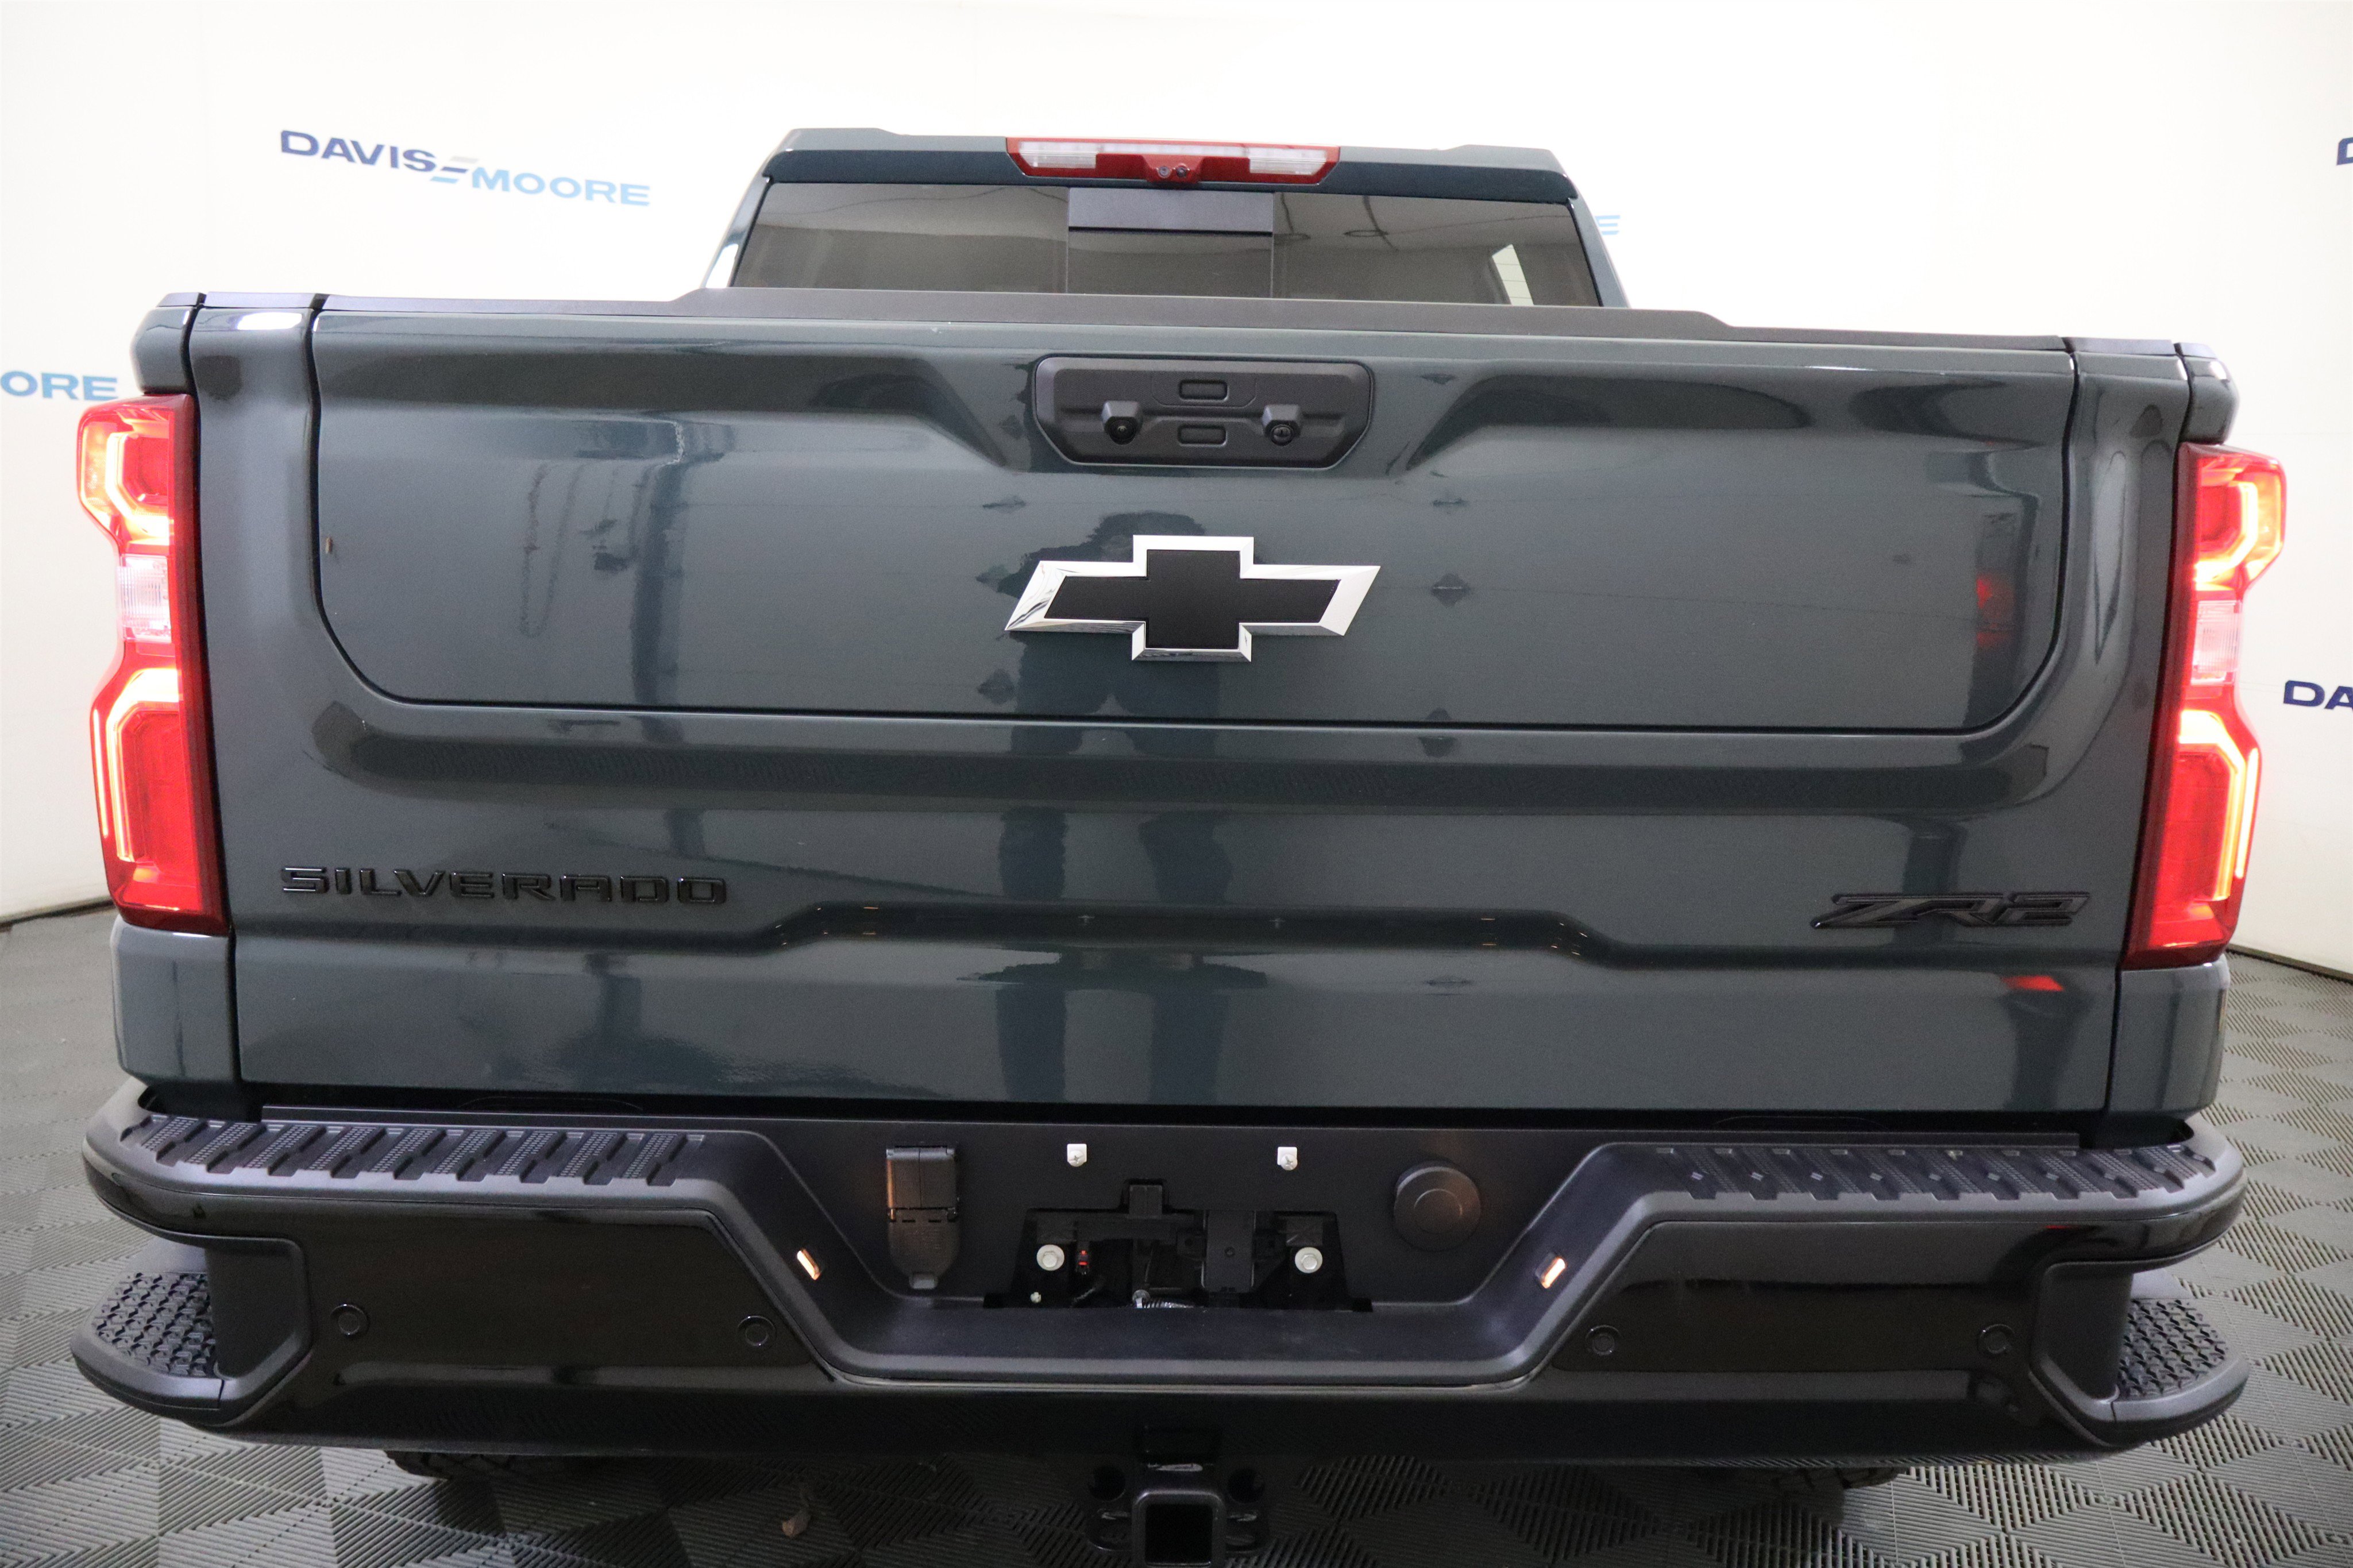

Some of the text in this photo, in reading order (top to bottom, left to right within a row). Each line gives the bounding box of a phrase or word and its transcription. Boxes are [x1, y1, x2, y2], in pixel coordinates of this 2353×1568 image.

[281, 130, 650, 207] DAVIS MOORE
[280, 866, 727, 905] SILVERADO
[1810, 891, 2090, 929] ZR2
